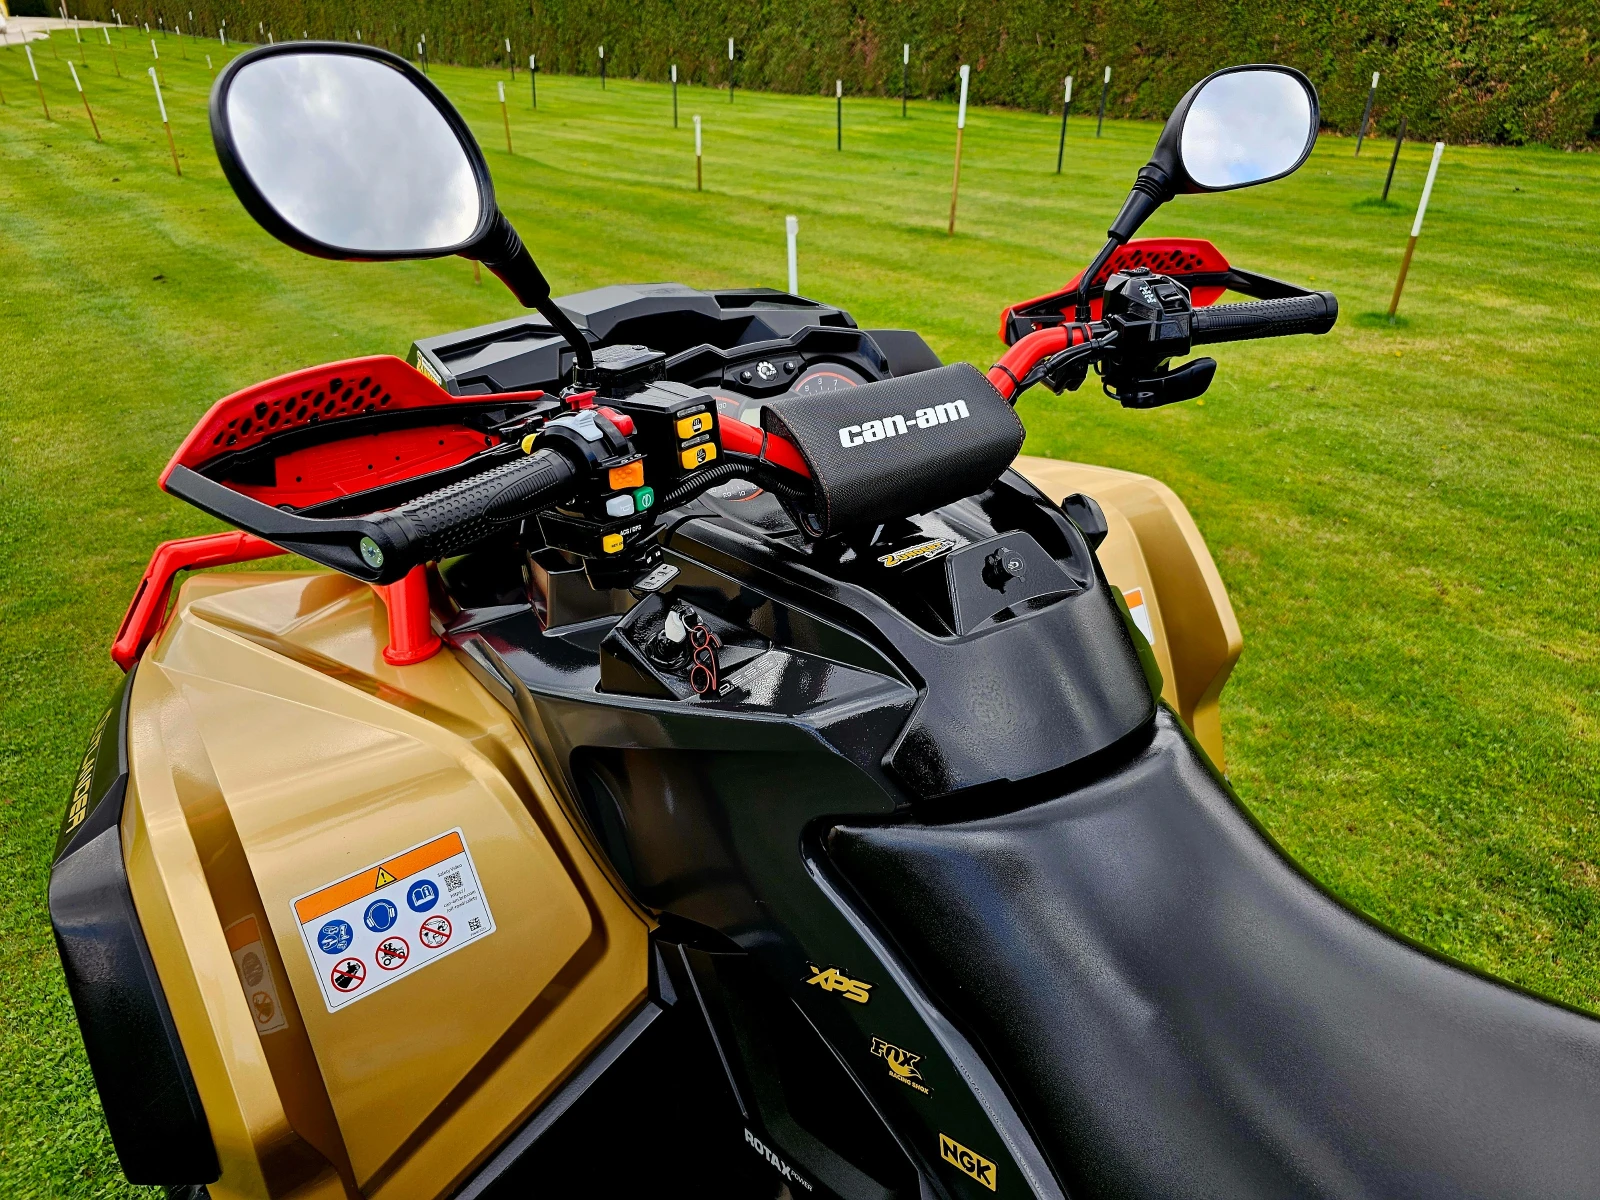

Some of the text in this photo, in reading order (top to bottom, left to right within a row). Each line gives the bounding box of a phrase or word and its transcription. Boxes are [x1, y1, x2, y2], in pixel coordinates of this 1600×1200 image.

[838, 399, 970, 448] can-am
[806, 965, 872, 1004] XPS
[870, 1036, 920, 1067] FOX
[888, 1070, 929, 1095] RACING SHOX
[744, 1127, 813, 1192] ROTAX POWER
[939, 1136, 992, 1186] NGK
